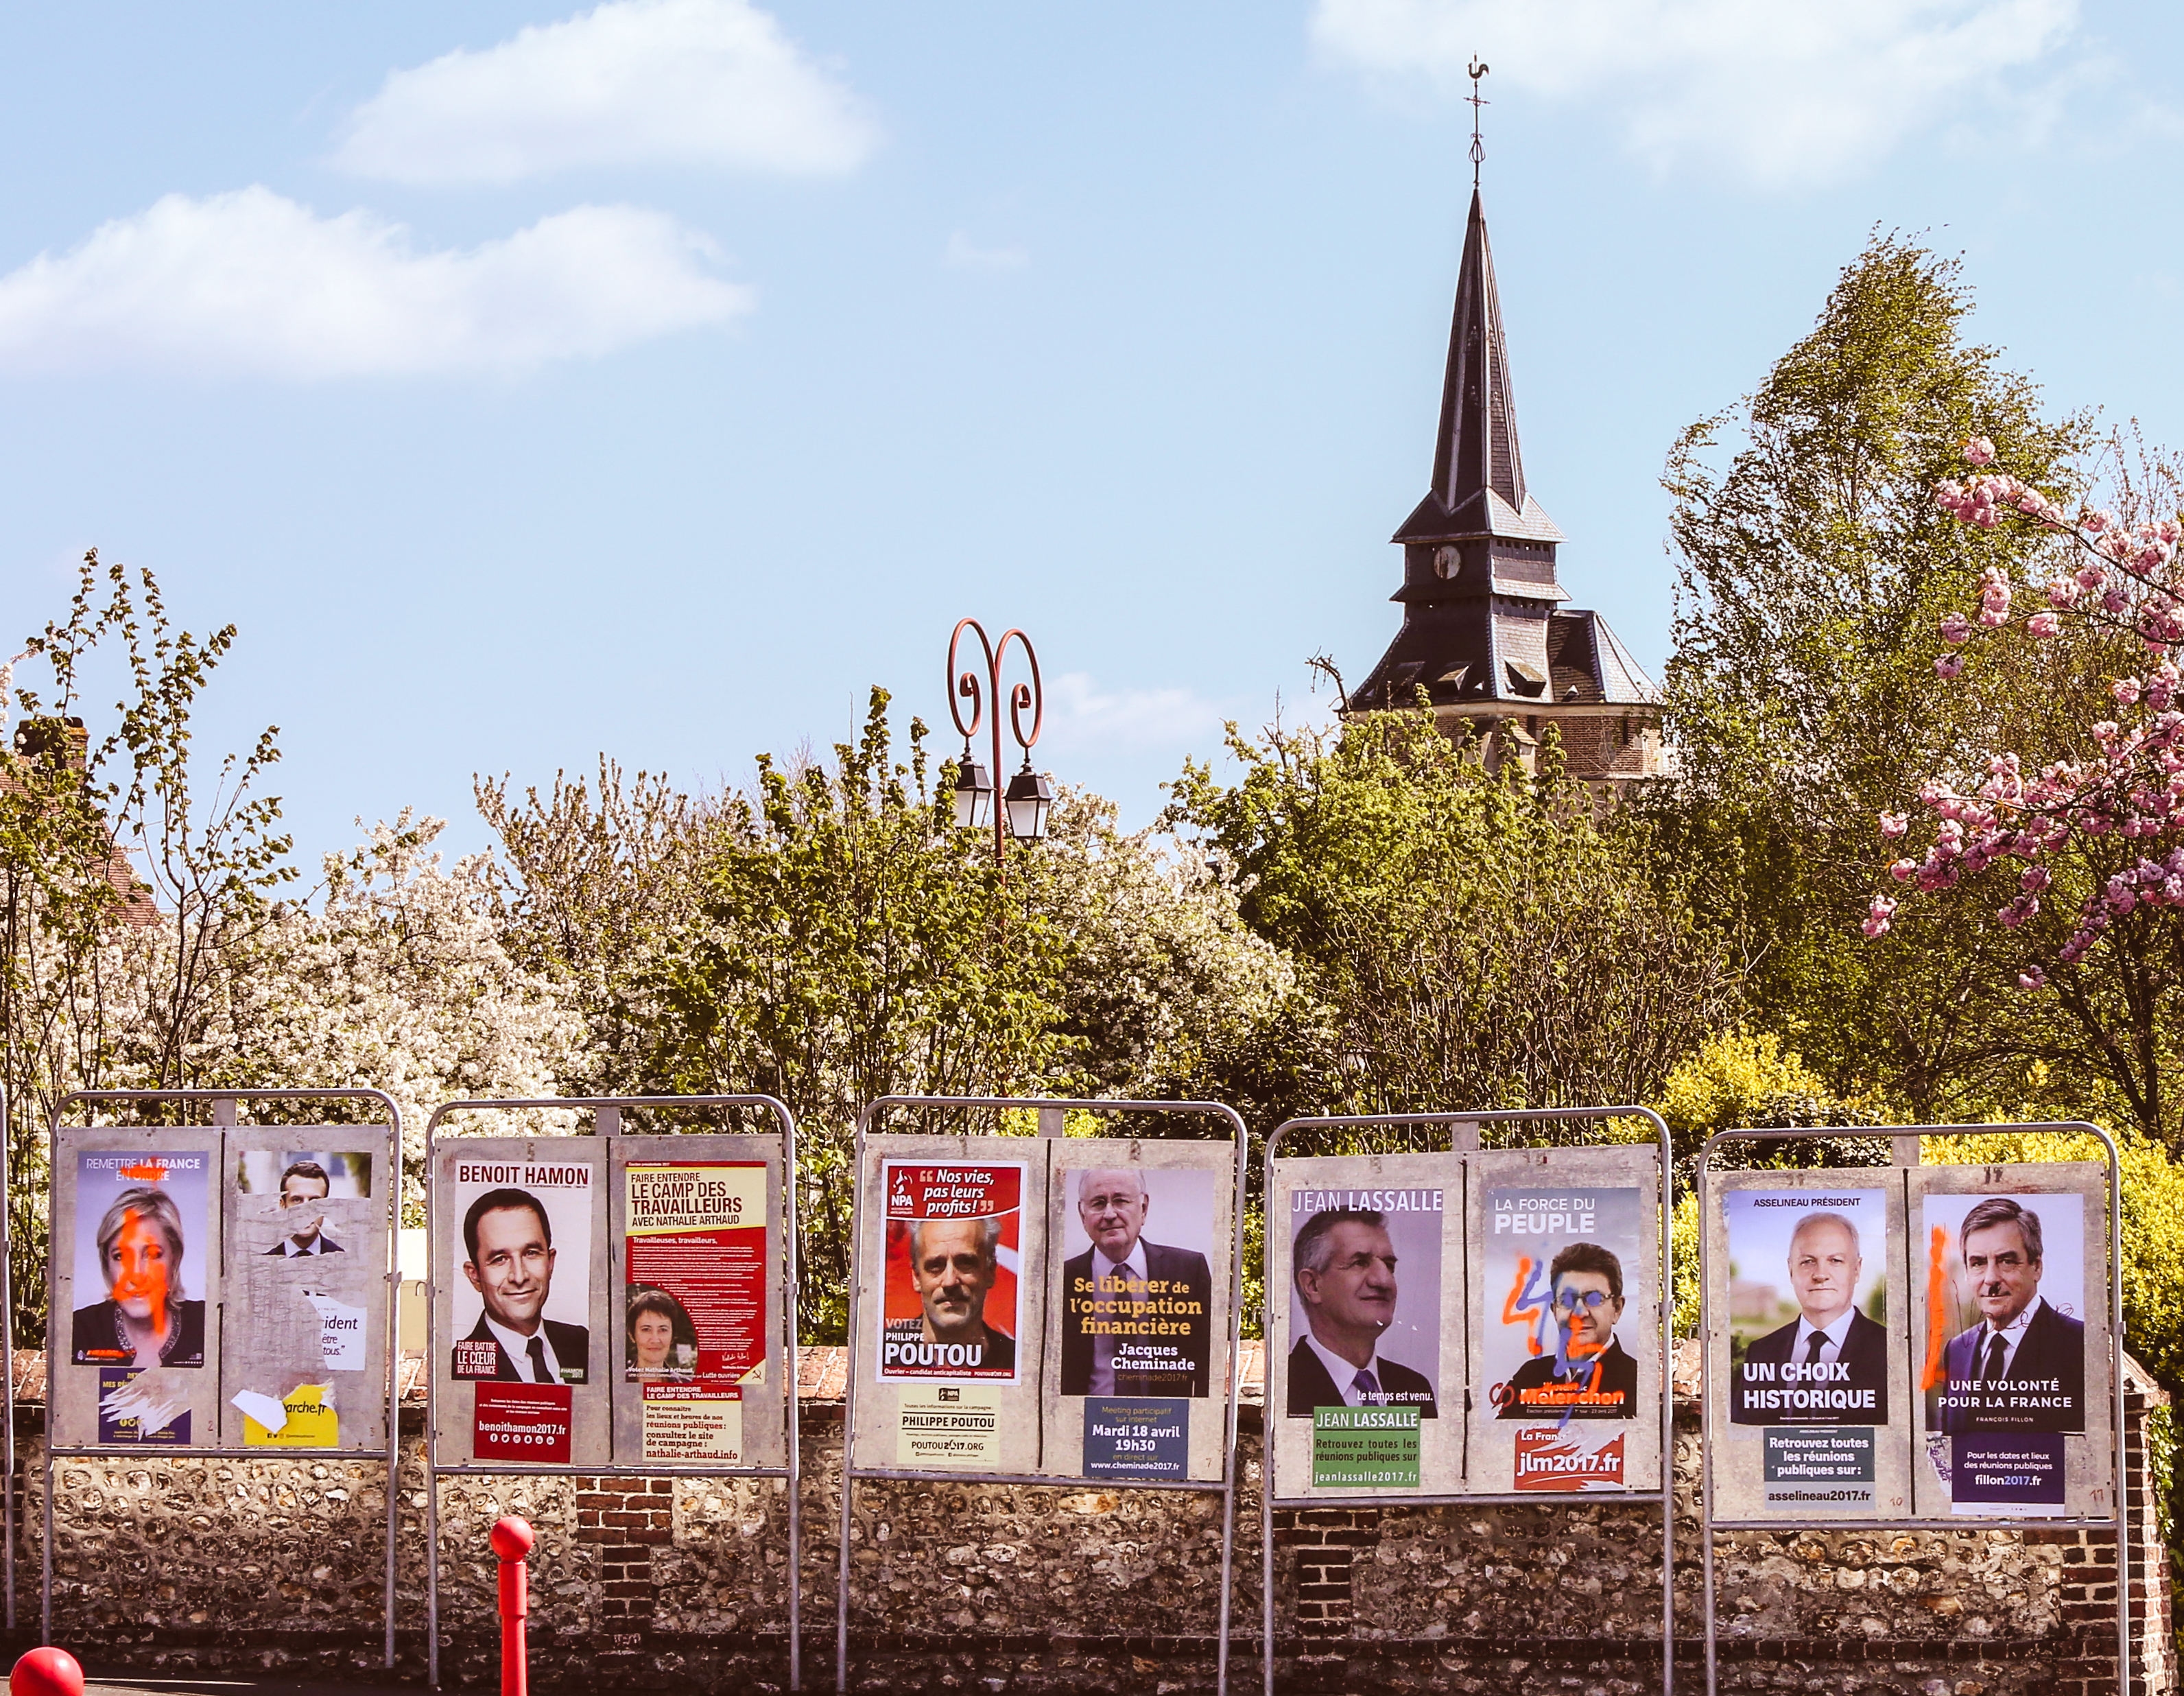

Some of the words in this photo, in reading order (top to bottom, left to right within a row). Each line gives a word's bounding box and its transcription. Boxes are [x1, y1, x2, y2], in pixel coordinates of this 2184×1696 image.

[86, 1159, 136, 1168] REMETTRE
[140, 1159, 153, 1168] LA
[156, 1159, 200, 1168] FRANCE
[460, 1166, 520, 1183] BENOIT
[525, 1167, 588, 1184] HAMON
[631, 1174, 654, 1183] FAIRE
[657, 1173, 700, 1181] ENTENDRE
[936, 1169, 961, 1183] Nos
[964, 1169, 995, 1185] vies,
[632, 1184, 648, 1199] LE
[652, 1183, 694, 1198] CAMP
[698, 1181, 726, 1197] DES
[923, 1187, 948, 1201] pas
[951, 1184, 984, 1198] leurs
[632, 1197, 742, 1215] TRAVAILLEURS
[892, 1194, 914, 1206] NPA
[1292, 1192, 1340, 1212] JEAN
[1349, 1190, 1443, 1212] LASSALLE
[1495, 1199, 1512, 1211] LA
[1519, 1199, 1567, 1210] FORCE
[1574, 1198, 1595, 1210] DU
[1811, 1197, 1860, 1206] PRÉSIDENT
[632, 1217, 654, 1227] AVEC
[656, 1216, 697, 1226] NATHALIE
[699, 1214, 739, 1225] ARTHAUD
[1495, 1213, 1595, 1234] PEUPLE
[1074, 1277, 1094, 1293] Se
[1099, 1275, 1170, 1293] libérer
[1172, 1281, 1189, 1293] de
[885, 1318, 923, 1330] VOTEZ
[1080, 1316, 1191, 1335] financière
[886, 1332, 925, 1341] PHILIPPE
[458, 1341, 473, 1350] FAIRE
[475, 1342, 496, 1352] BATTRE
[1119, 1343, 1178, 1358] Jacques
[458, 1351, 468, 1365] LE
[470, 1352, 496, 1365] CŒUR
[885, 1343, 982, 1367] POUTOU
[458, 1365, 465, 1374] DE
[466, 1365, 473, 1374] LA
[474, 1365, 496, 1374] FRANCE
[1111, 1357, 1195, 1371] Cheminade
[1744, 1363, 1775, 1381] UN
[1781, 1363, 1850, 1381] CHOIX
[1950, 1380, 1982, 1391] UNE
[1987, 1378, 2059, 1391] VOLONTÉ
[1357, 1390, 1366, 1400] Le
[1368, 1391, 1394, 1403] temps
[1396, 1391, 1408, 1401] est
[1410, 1392, 1433, 1401] venu.
[1744, 1389, 1876, 1409] HISTORIQUE
[1938, 1397, 1980, 1407] POUR
[1986, 1397, 2005, 1407] LA
[2010, 1397, 2072, 1407] FRANCE
[284, 1402, 327, 1415] arche.fr
[1102, 1406, 1130, 1415] Meeting
[1132, 1407, 1172, 1415] participatif
[902, 1416, 949, 1426] PHILIPPE
[951, 1417, 995, 1428] POUTOU
[1316, 1413, 1349, 1427] JEAN
[1354, 1413, 1418, 1427] LASSALLE
[479, 1420, 566, 1435] benoithamon2017.fr
[1092, 1424, 1129, 1436] Mardi
[1132, 1426, 1148, 1437] 18
[1150, 1426, 1180, 1437] avril
[1521, 1432, 1532, 1440] La
[912, 1439, 984, 1450] POUTOU2017.ORG
[1115, 1439, 1156, 1451] 19h30
[1316, 1439, 1363, 1448] Retrouvez
[1368, 1439, 1398, 1448] toutes
[1403, 1439, 1416, 1448] les
[1769, 1437, 1829, 1448] Retrouvez
[1831, 1438, 1868, 1448] toutes
[646, 1449, 737, 1459] nathalie-arthaud.info
[1316, 1451, 1353, 1461] réunions
[1357, 1451, 1399, 1463] publiques
[1783, 1451, 1801, 1461] les
[1803, 1450, 1855, 1461] réunions
[1999, 1452, 2019, 1460] dates
[2031, 1452, 2050, 1460] lieux
[1091, 1461, 1180, 1471] www.cheminade2017.fr
[1206, 1458, 1211, 1468] 7
[1517, 1452, 1620, 1476] jlm2017.fr
[1979, 1461, 2013, 1470] réunions
[2014, 1462, 2052, 1471] publiques
[1777, 1464, 1834, 1477] publiques
[1314, 1472, 1417, 1484] jeanlassalle2017.fr
[1975, 1474, 2041, 1485] fillon2017.fr
[1768, 1490, 1871, 1501] asselineau2017.fr
